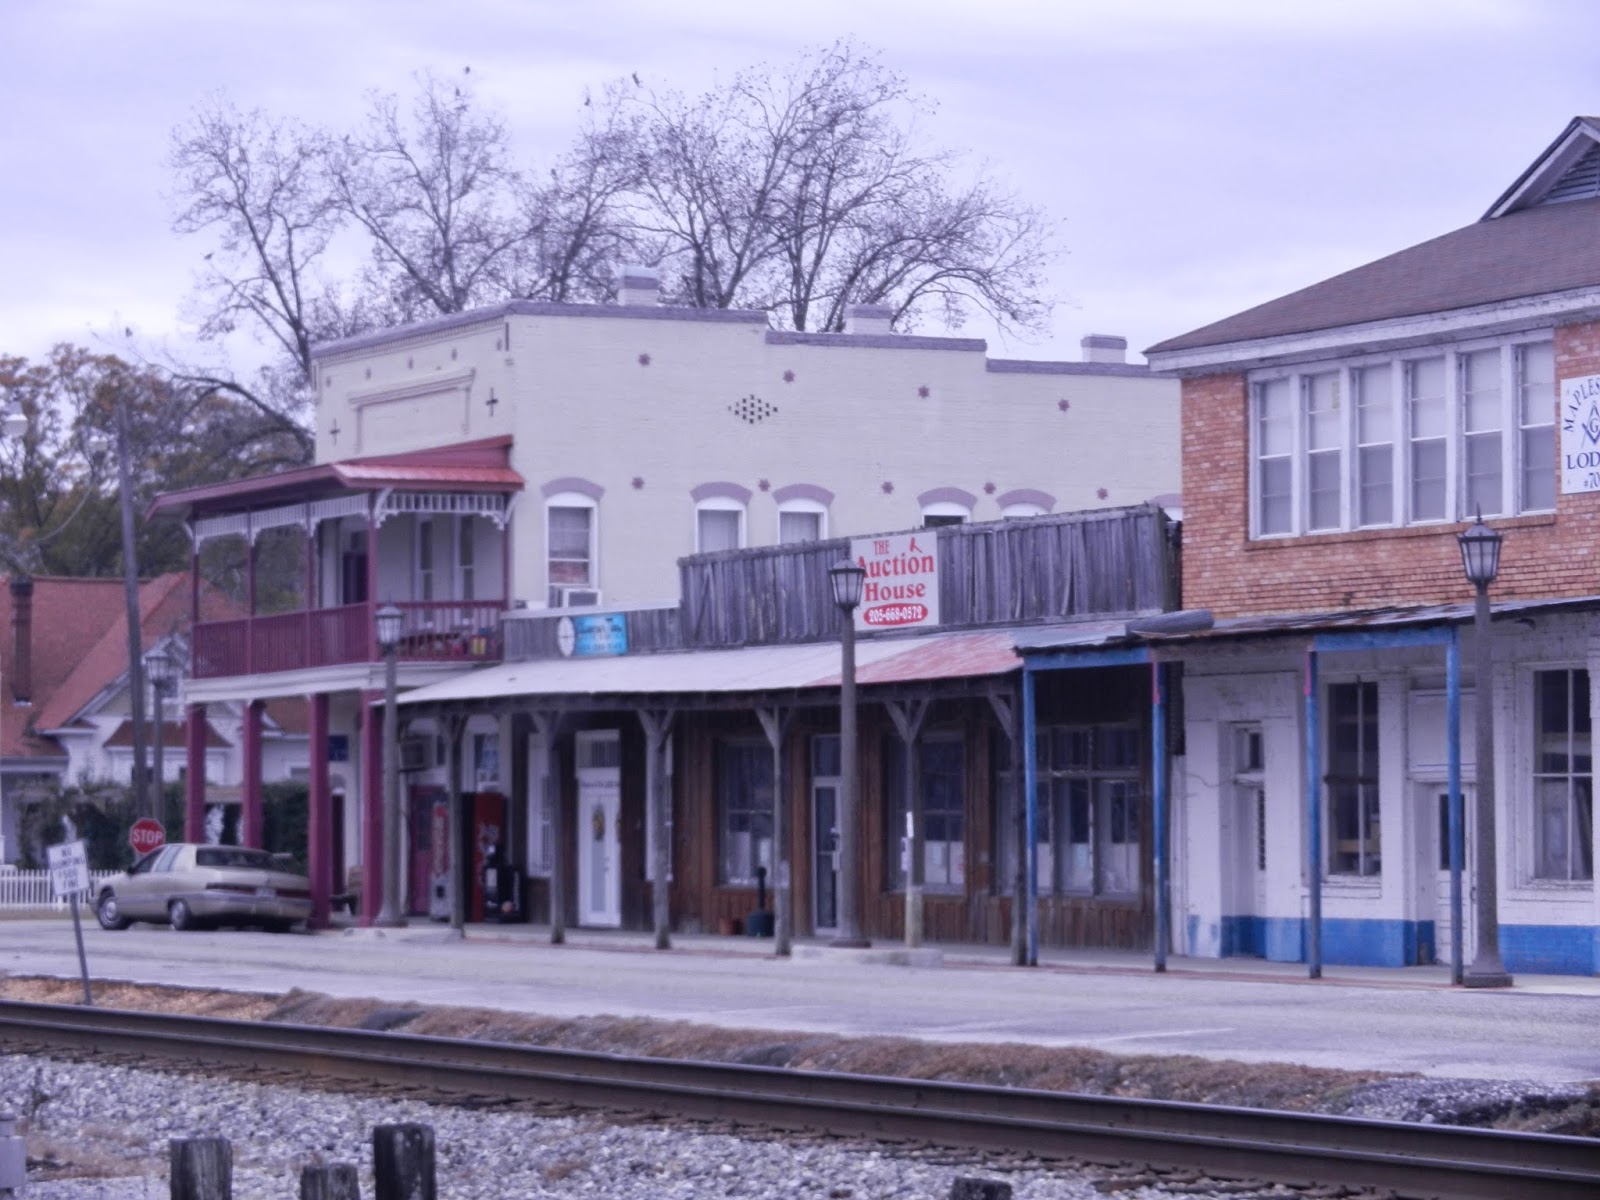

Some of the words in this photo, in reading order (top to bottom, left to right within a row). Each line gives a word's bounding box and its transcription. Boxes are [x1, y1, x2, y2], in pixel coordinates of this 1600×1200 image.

[873, 540, 889, 555] THE
[858, 552, 935, 578] Auction
[864, 582, 926, 602] House
[132, 829, 163, 843] STOP
[61, 846, 72, 858] NO
